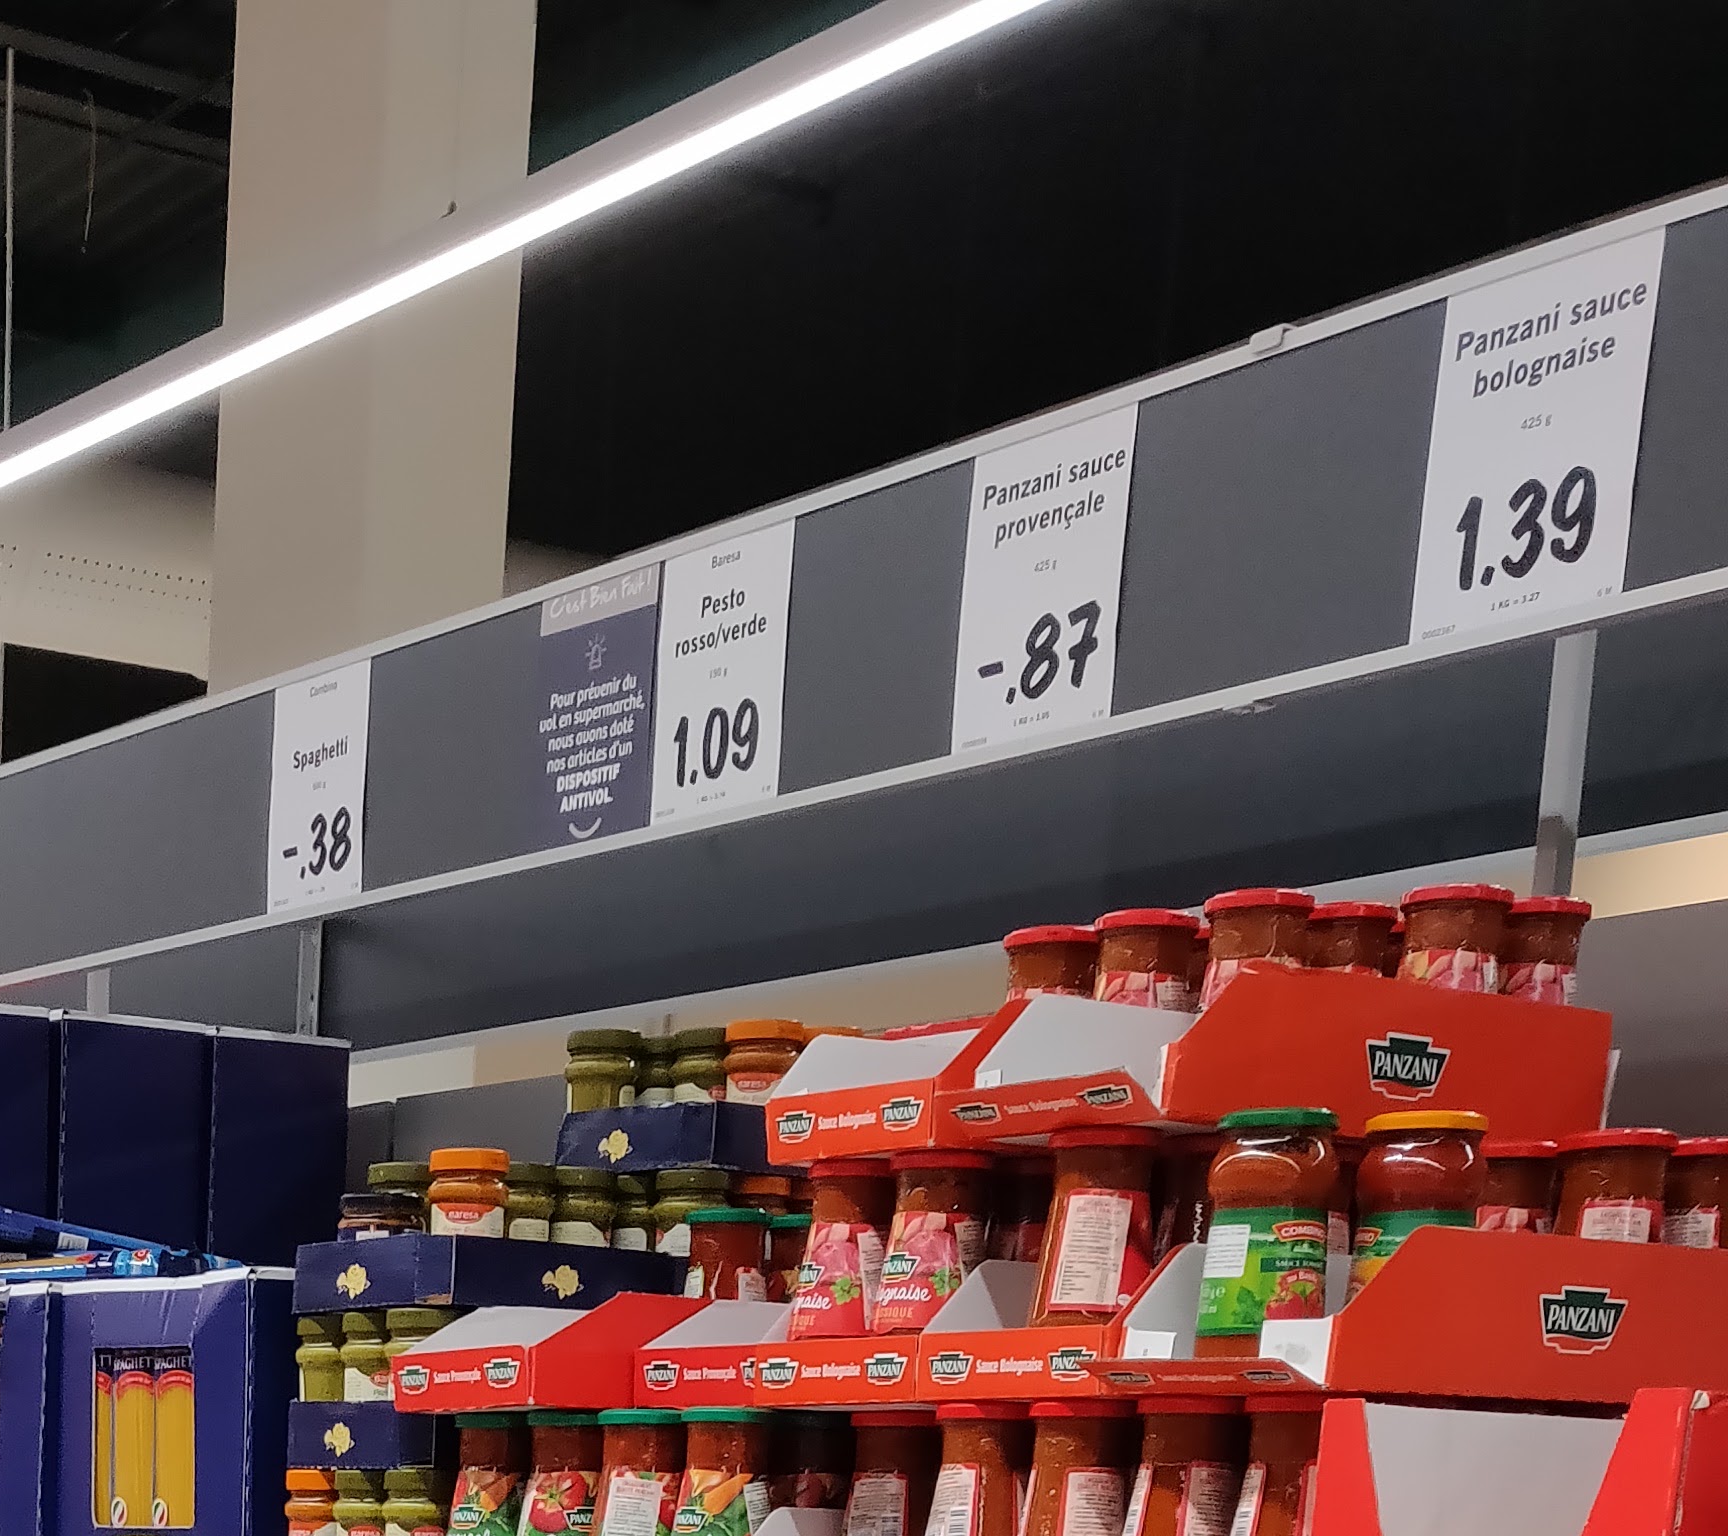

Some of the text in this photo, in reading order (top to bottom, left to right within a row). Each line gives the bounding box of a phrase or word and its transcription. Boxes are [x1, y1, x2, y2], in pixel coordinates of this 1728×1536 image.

[1455, 282, 1647, 362] Panzani sauce
[1472, 336, 1616, 398] bolognaise
[1520, 414, 1542, 430] 425
[983, 449, 1126, 510] Panzani sauce
[994, 490, 1105, 549] provençale
[1456, 465, 1597, 591] 1.39
[712, 551, 741, 569] Baresa
[550, 589, 587, 618] C'est
[590, 585, 617, 606] Bien
[701, 588, 745, 618] Pesto
[675, 613, 767, 658] rosso/verde
[978, 600, 1101, 705] -.87
[550, 673, 637, 710] Pour prévenir du
[539, 690, 645, 733] vol en supermarché,
[548, 714, 634, 752] nous avons doté
[674, 698, 759, 787] 1.09
[293, 735, 349, 772] Spaghetti
[547, 741, 632, 774] nos articles d'un
[556, 762, 621, 793] DISPOSITIF
[283, 806, 351, 880] -.38
[1373, 1050, 1438, 1082] PANZANI
[779, 1104, 920, 1135] PANZANI PANZANI
[1546, 1308, 1620, 1337] PANZANI
[401, 1367, 516, 1386] PANZANI PANZANI
[646, 1369, 676, 1383] PANZANI
[761, 1367, 797, 1381] PANZANI
[867, 1362, 904, 1377] PANZANI
[931, 1356, 1043, 1375] PANZANI Sauce Bolognaise
